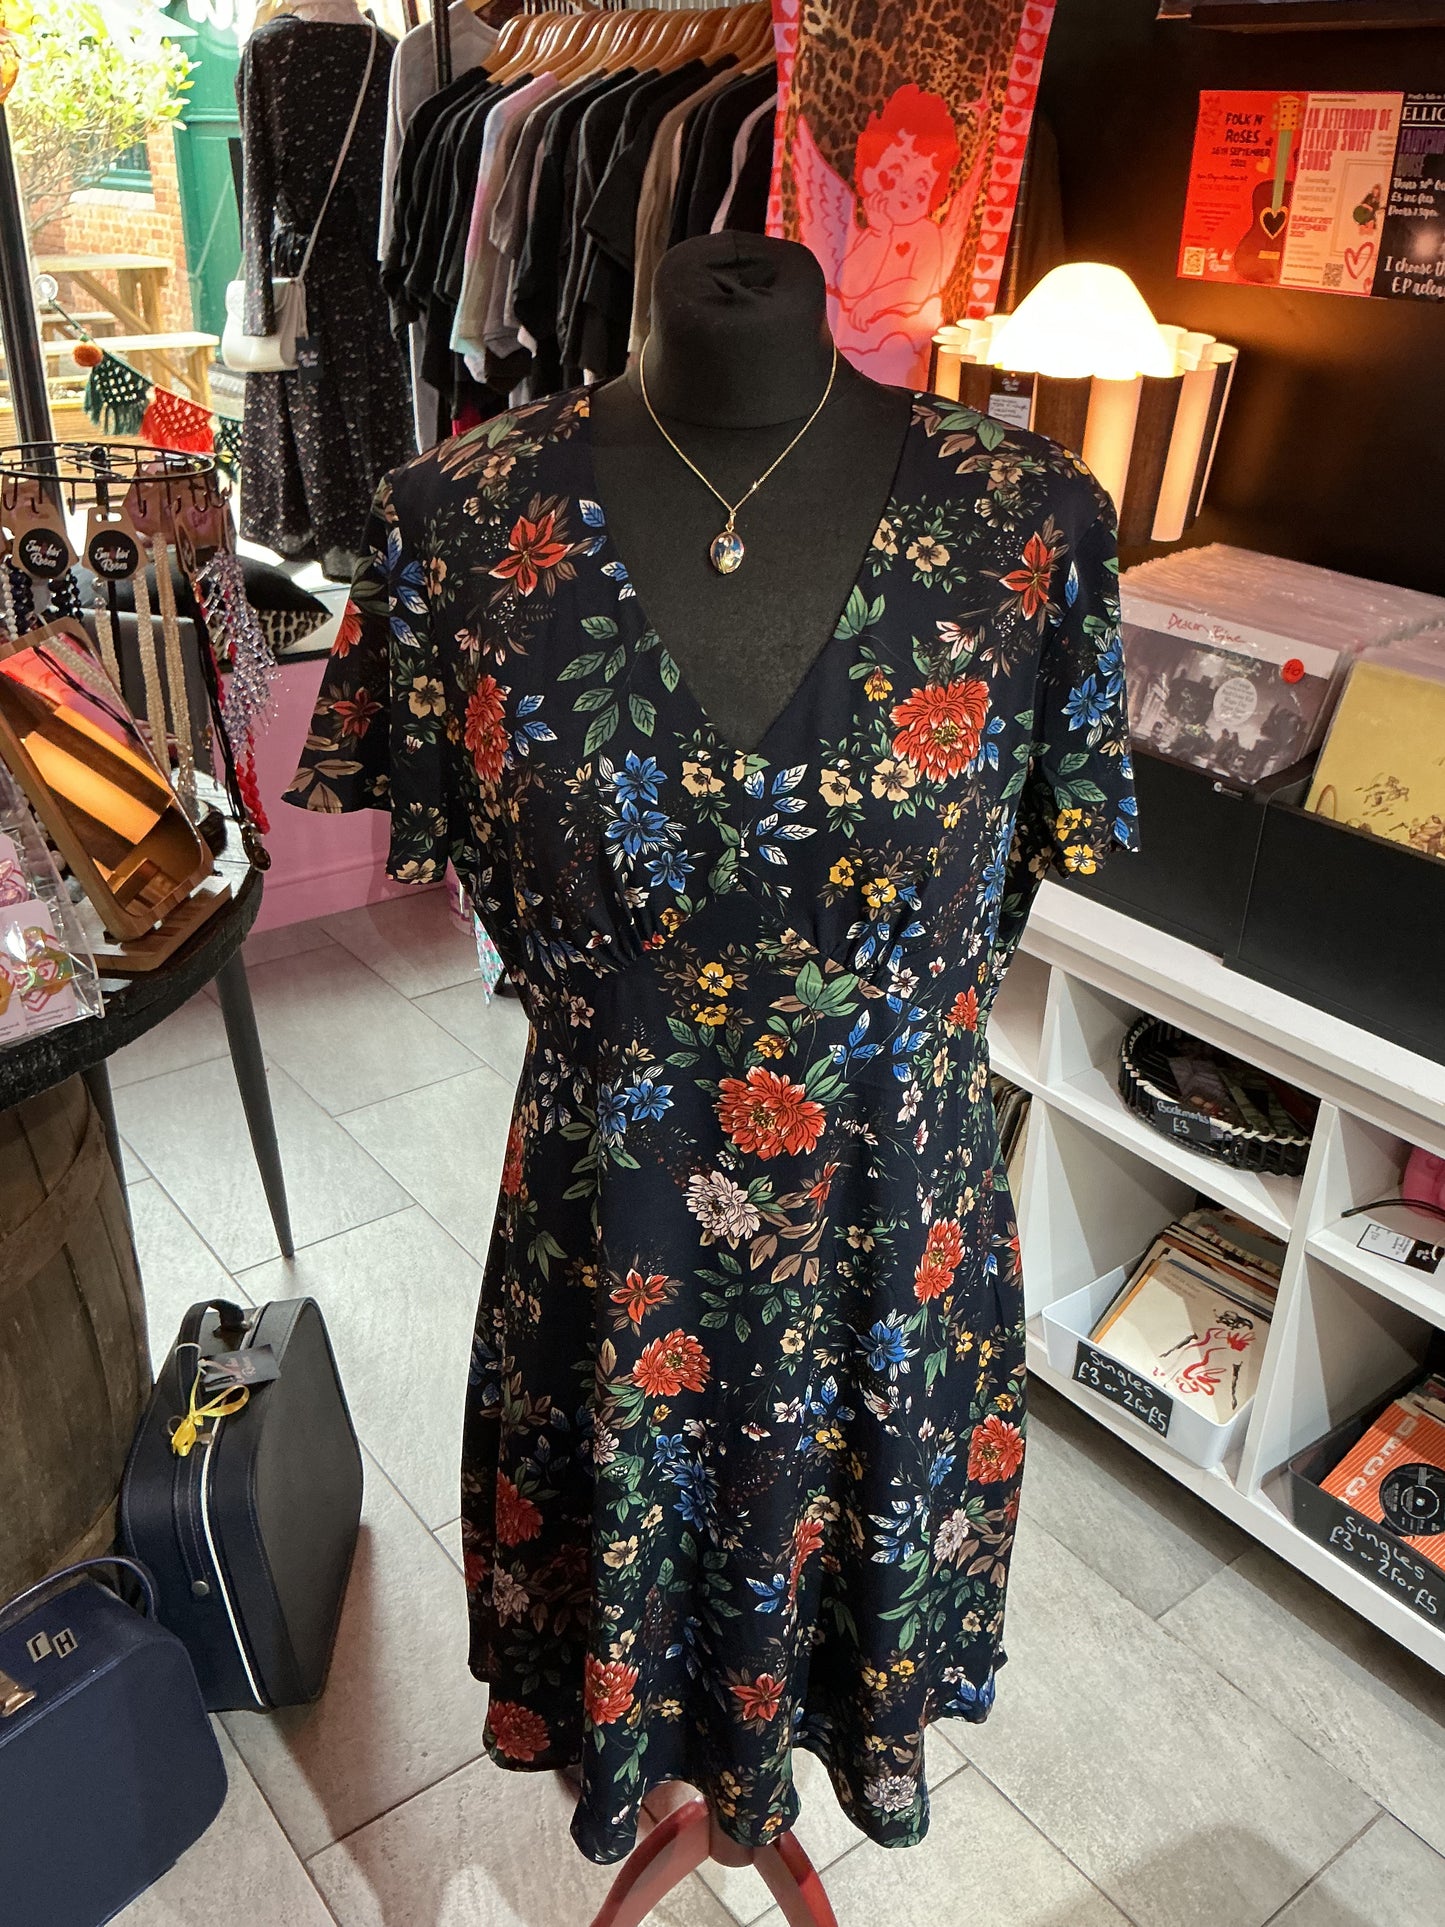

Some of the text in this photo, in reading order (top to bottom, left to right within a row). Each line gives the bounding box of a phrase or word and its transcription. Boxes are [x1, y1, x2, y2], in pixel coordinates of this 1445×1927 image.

[1225, 112, 1251, 126] FOLK
[1321, 108, 1378, 130] AFTERNOON
[1378, 108, 1393, 131] OF
[1230, 147, 1271, 157] SEPTEMBER
[1303, 129, 1340, 150] TAYLOR
[1340, 130, 1372, 152] SWIFT
[1300, 150, 1333, 171] SONGS
[1383, 255, 1393, 272] I
[1395, 257, 1433, 275] choose
[1167, 612, 1209, 633] Deacon
[1156, 1100, 1210, 1124] Bookmarks
[1090, 1350, 1154, 1399] Singles
[1077, 1361, 1100, 1386] £3
[1104, 1383, 1119, 1392] or
[1148, 1406, 1167, 1432] £5
[1338, 1416, 1419, 1505] DECC
[1345, 1516, 1426, 1581] Singles
[1329, 1525, 1355, 1552] £3
[1360, 1551, 1374, 1562] or
[1414, 1588, 1437, 1615] £5
